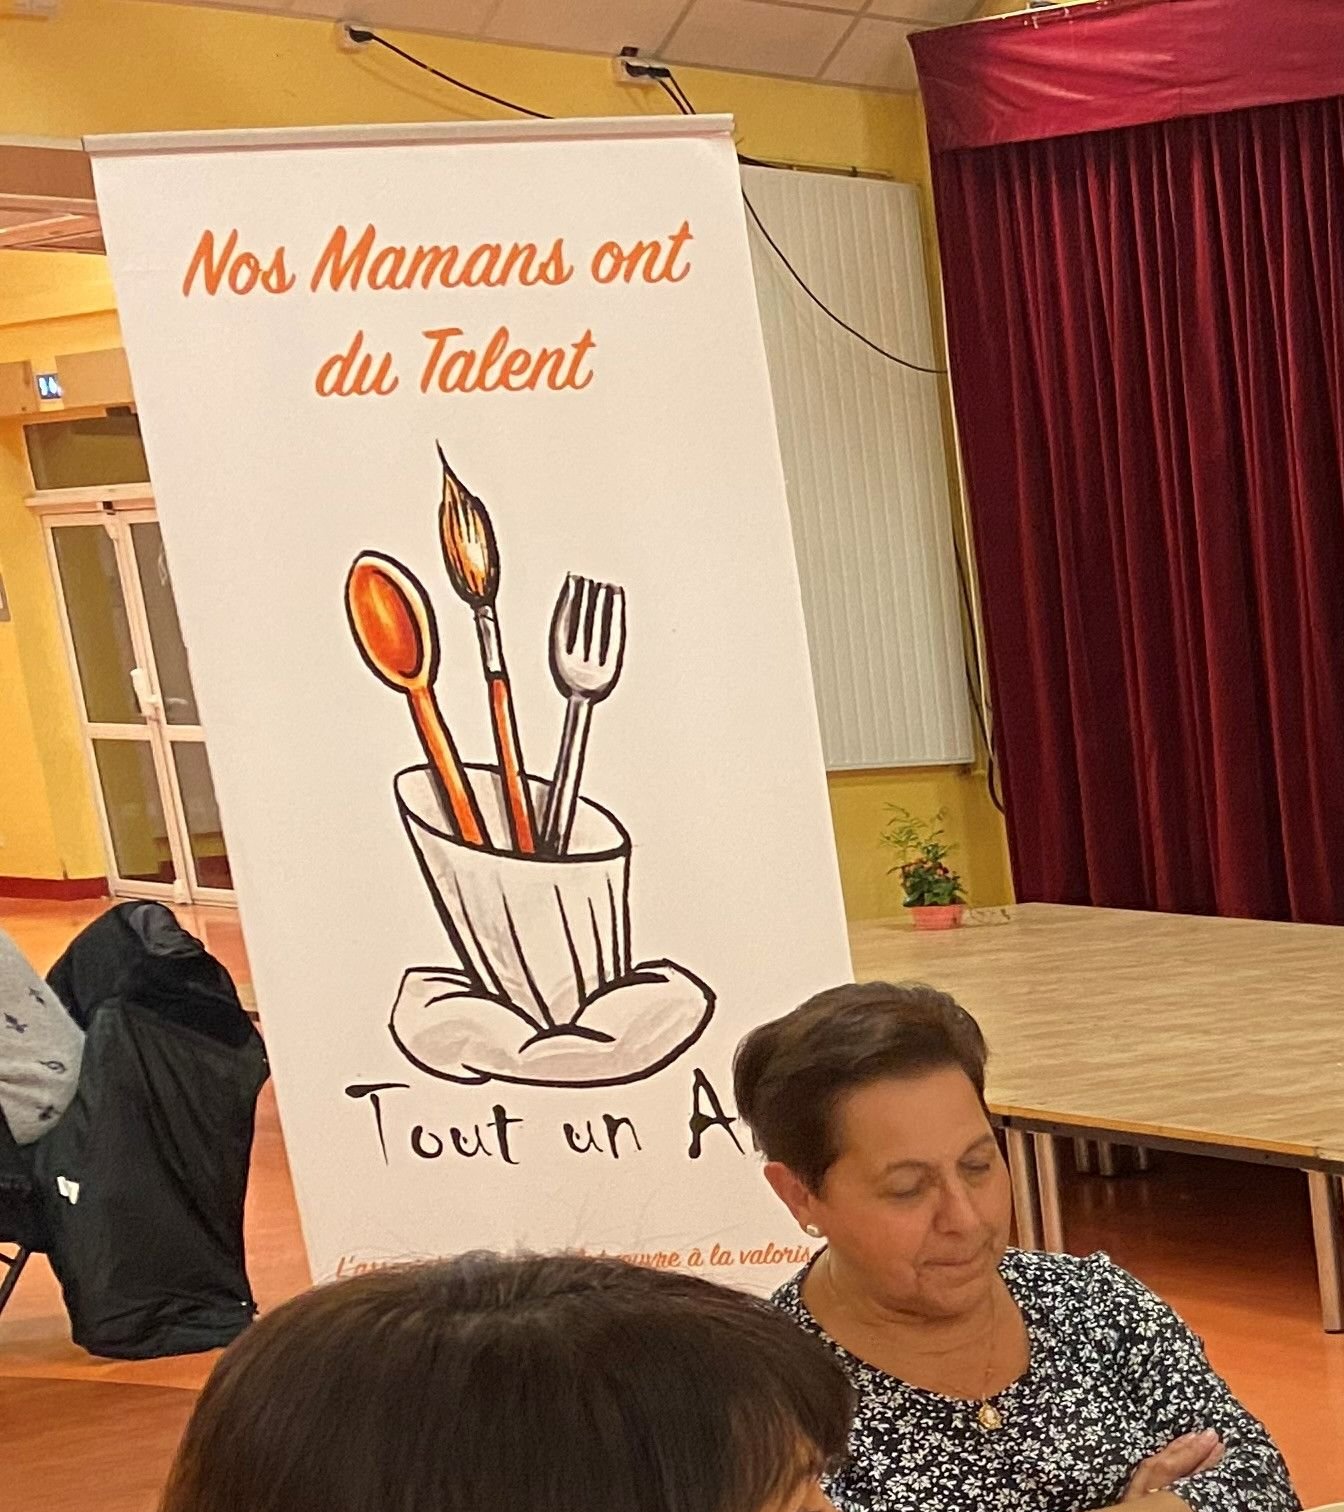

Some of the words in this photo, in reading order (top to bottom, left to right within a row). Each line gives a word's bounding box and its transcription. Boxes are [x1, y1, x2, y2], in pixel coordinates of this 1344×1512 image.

[182, 229, 295, 297] Nos
[310, 224, 574, 292] Mamans
[591, 221, 694, 286] ont
[315, 330, 400, 398] du
[419, 326, 597, 395] Talent
[345, 1081, 524, 1165] Tout
[563, 1111, 642, 1160] un
[688, 1067, 746, 1159] A
[709, 1242, 733, 1267] la
[738, 1241, 811, 1266] valoris
